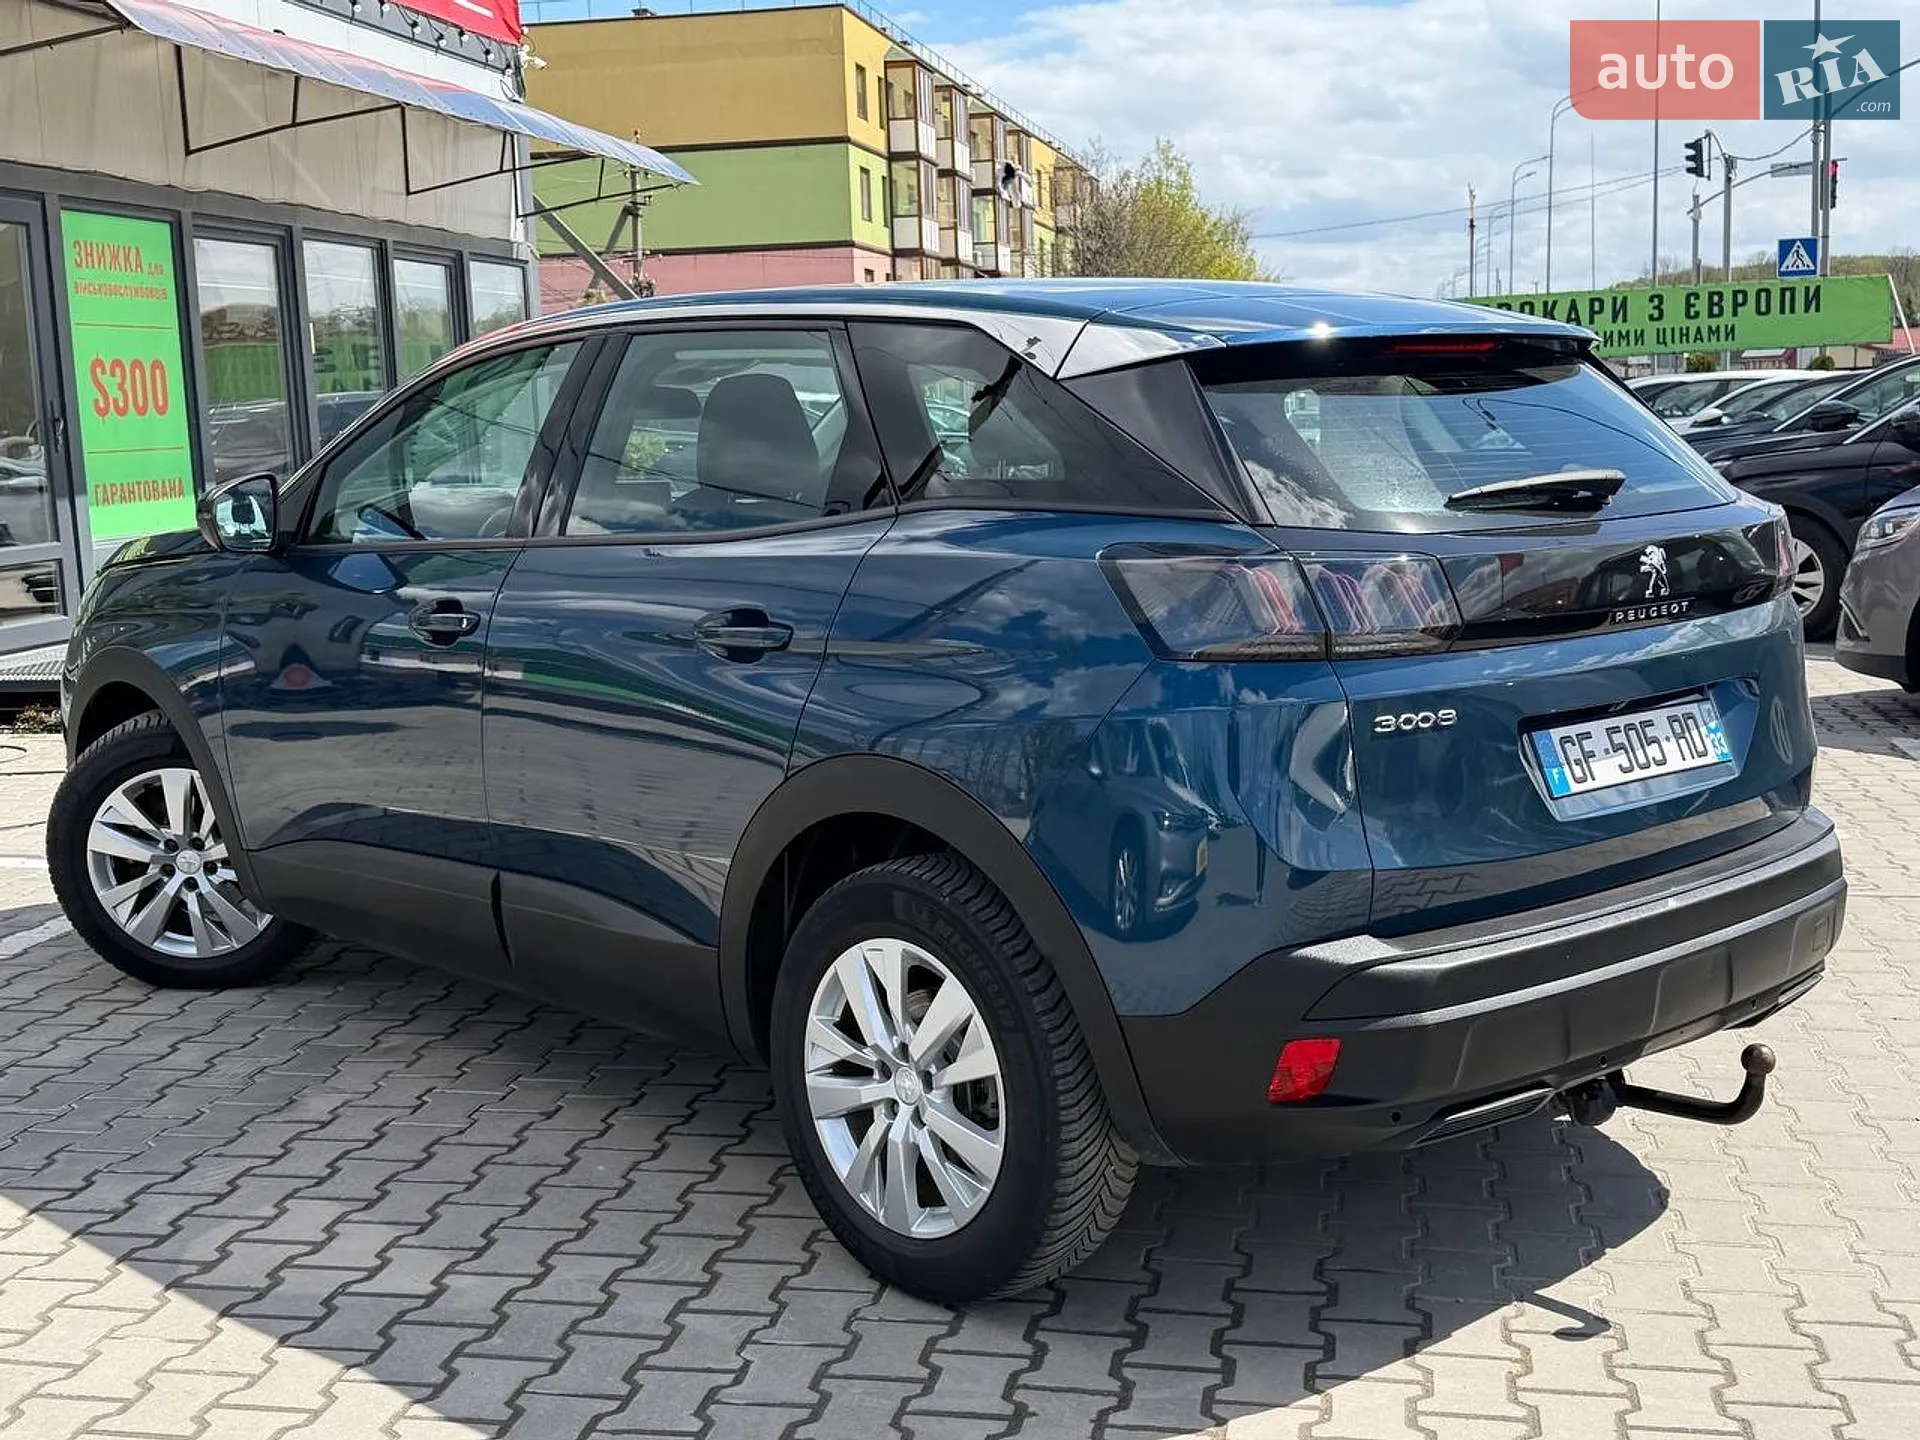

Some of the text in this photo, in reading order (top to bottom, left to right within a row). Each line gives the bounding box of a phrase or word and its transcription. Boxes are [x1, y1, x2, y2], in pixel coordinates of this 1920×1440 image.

[73, 240, 144, 273] ЗНИЖКА
[1648, 292, 1666, 322] З
[1684, 284, 1822, 321] ЄВРОПИ
[1596, 323, 1737, 351] ИМИ ЦІНАМИ
[90, 353, 169, 425] $300
[94, 478, 185, 507] ГАРАНТОВАНА
[1614, 601, 1691, 624] PEUGEOT
[1373, 708, 1458, 734] 3008
